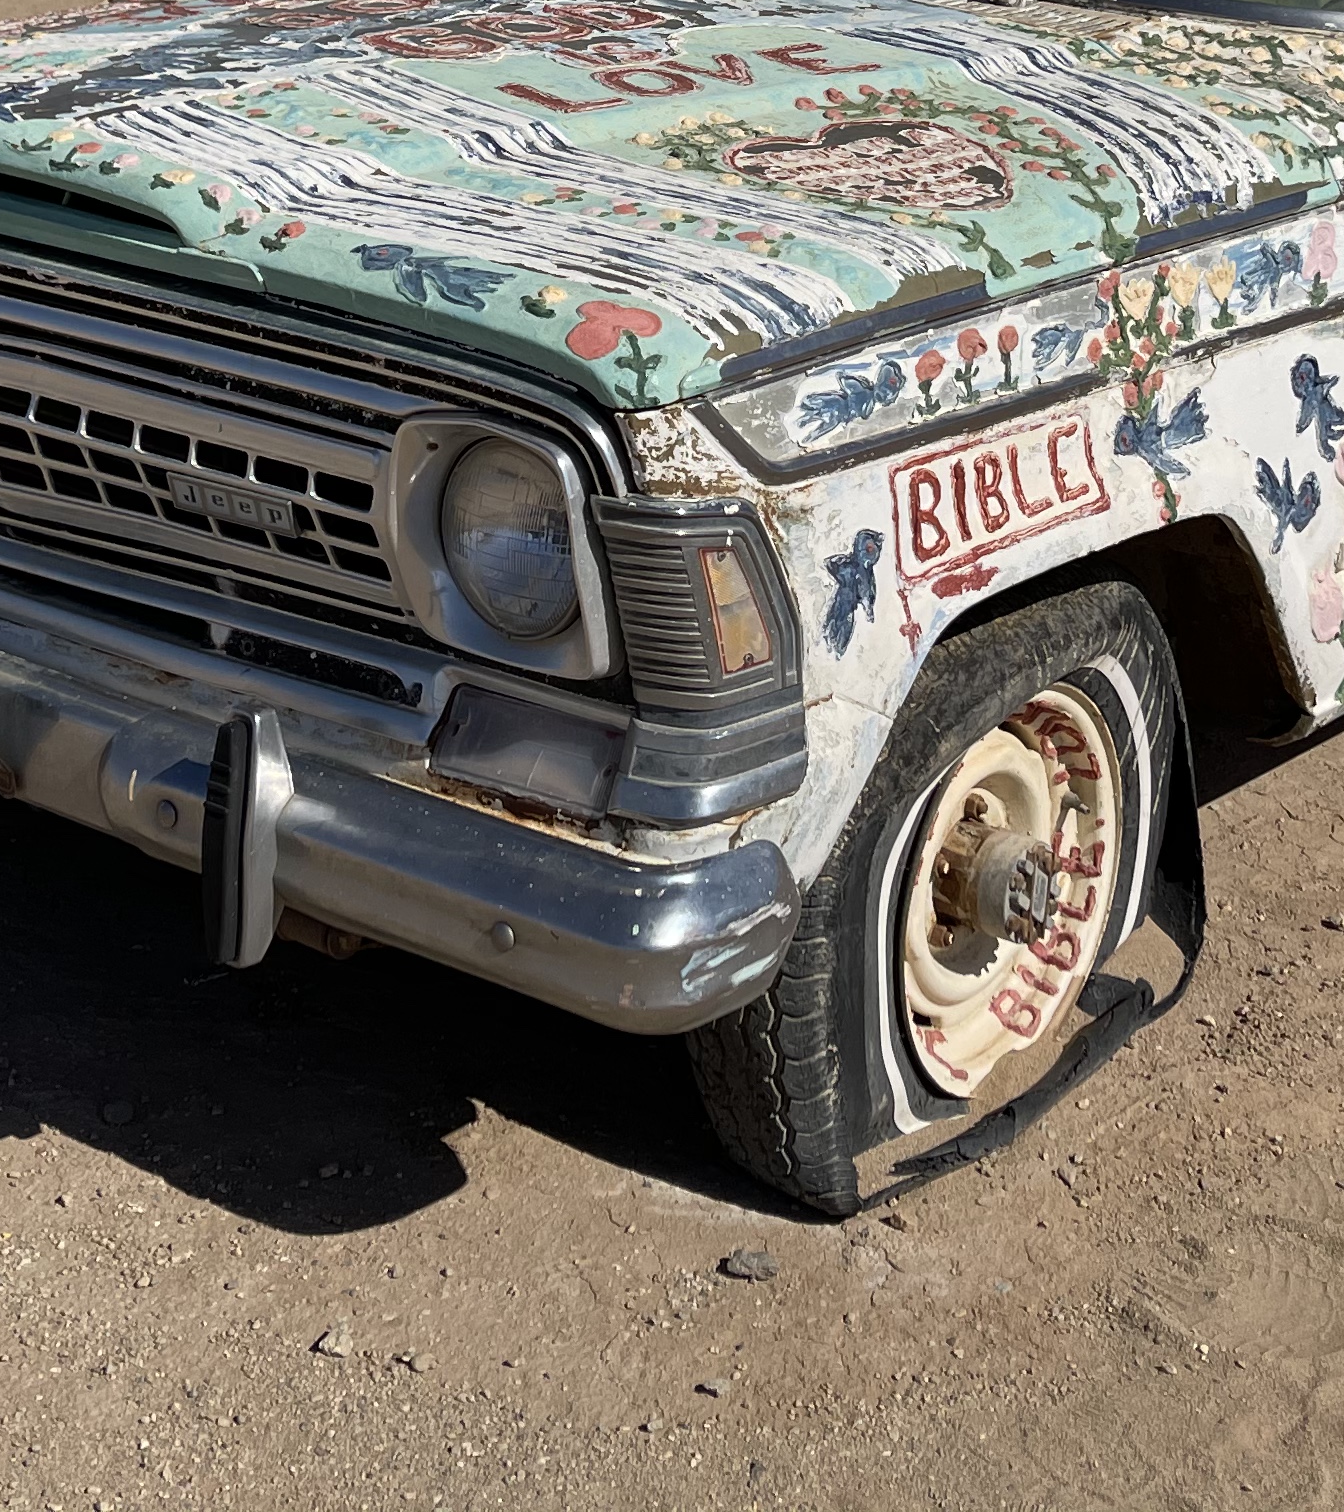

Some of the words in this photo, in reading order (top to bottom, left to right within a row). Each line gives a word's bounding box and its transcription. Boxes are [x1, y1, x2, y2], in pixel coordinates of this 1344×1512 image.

[360, 2, 666, 59] GOD
[494, 41, 884, 114] LOVE
[182, 485, 284, 525] Jeep
[908, 422, 1090, 564] BIBLE
